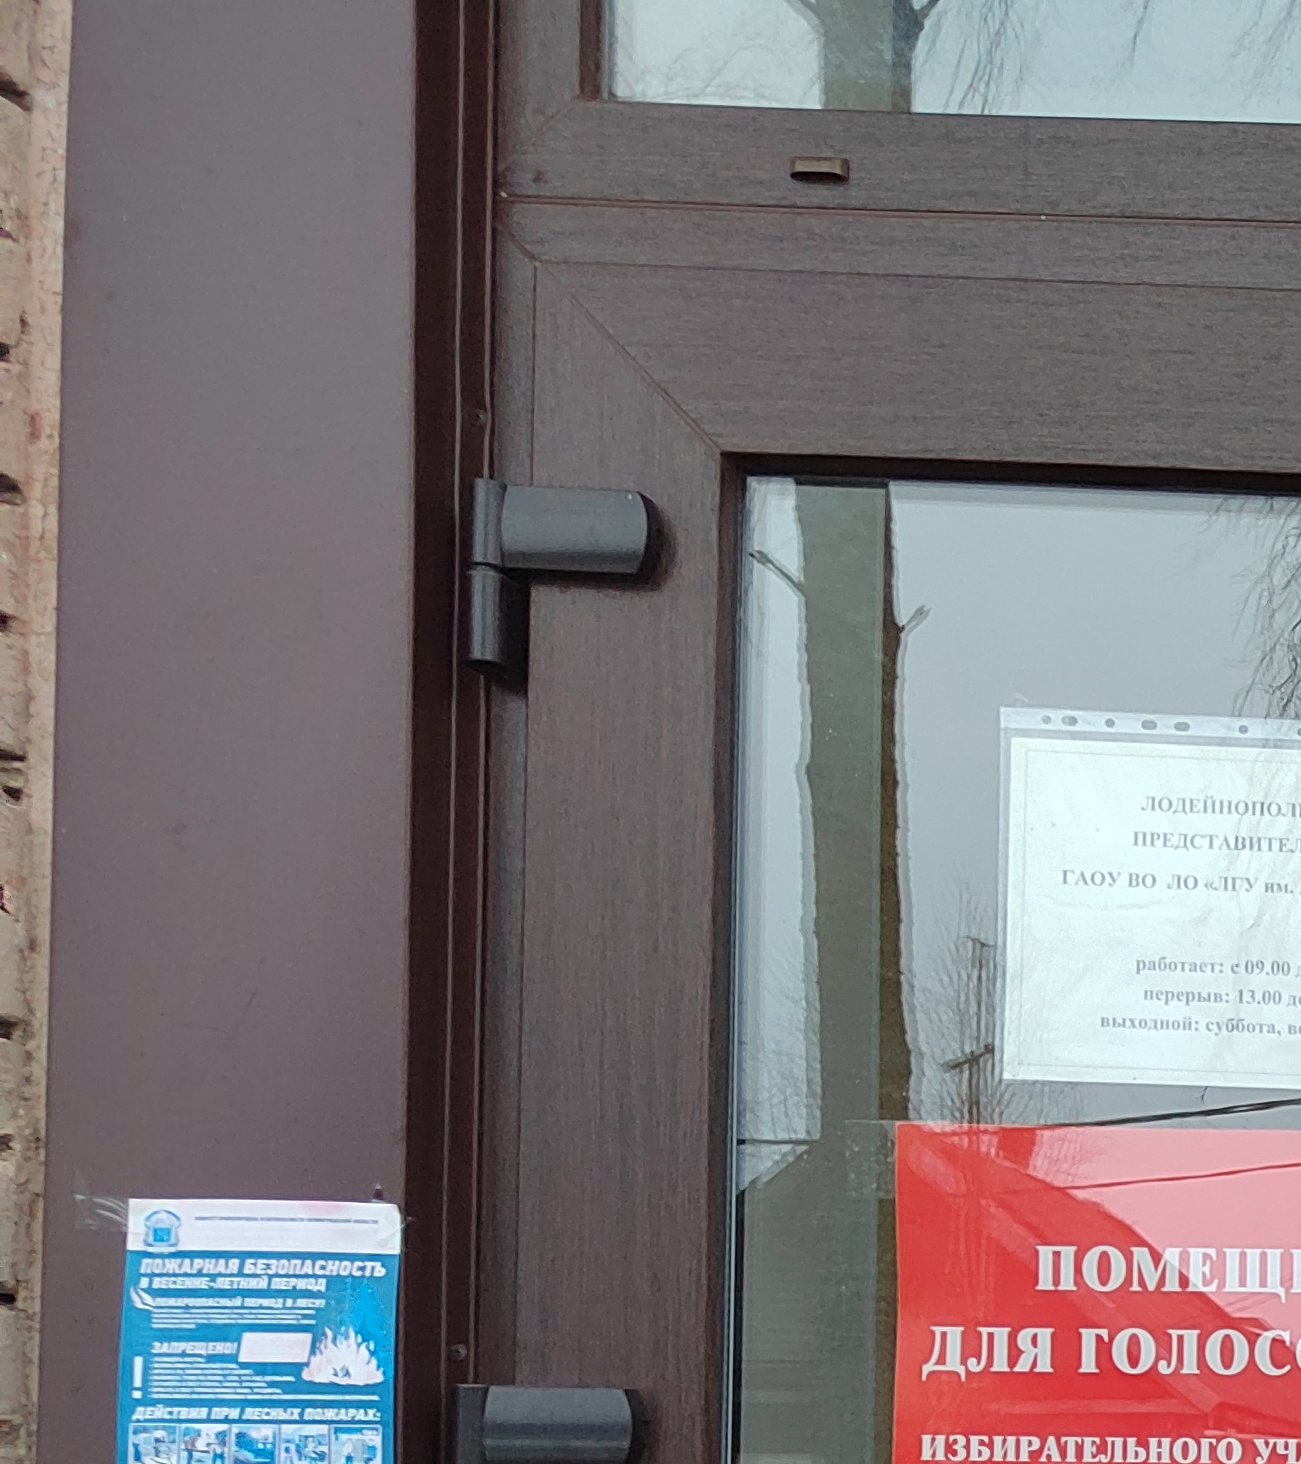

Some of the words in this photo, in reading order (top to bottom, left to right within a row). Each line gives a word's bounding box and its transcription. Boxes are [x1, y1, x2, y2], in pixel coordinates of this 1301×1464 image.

[1062, 869, 1121, 888] ГАОУ
[1128, 872, 1157, 889] ВО
[1167, 874, 1198, 892] ЛО
[1204, 876, 1258, 894] «ЛГУ
[1264, 882, 1294, 895] им.
[1135, 956, 1225, 977] работает:
[1230, 964, 1240, 975] с
[1244, 959, 1291, 977] 09.00
[1143, 989, 1230, 1008] перерыв:
[1237, 989, 1283, 1006] 13.00
[1100, 1014, 1200, 1033] выходной:
[1205, 1017, 1282, 1039] суббота,
[139, 1258, 240, 1275] ПОЖАРНАЯ
[243, 1259, 387, 1278] БЕЗОПАСНОСТЬ
[271, 1278, 327, 1292] ПЕРИОД
[921, 1326, 1054, 1381] ДЛЯ
[131, 1406, 208, 1421] ДЕЙСТВИЯ
[210, 1407, 240, 1420] ПРИ
[242, 1407, 300, 1421] ЛЕСНЫХ
[920, 1434, 1242, 1464] ИЗБИРАТЕЛЬНОГО
